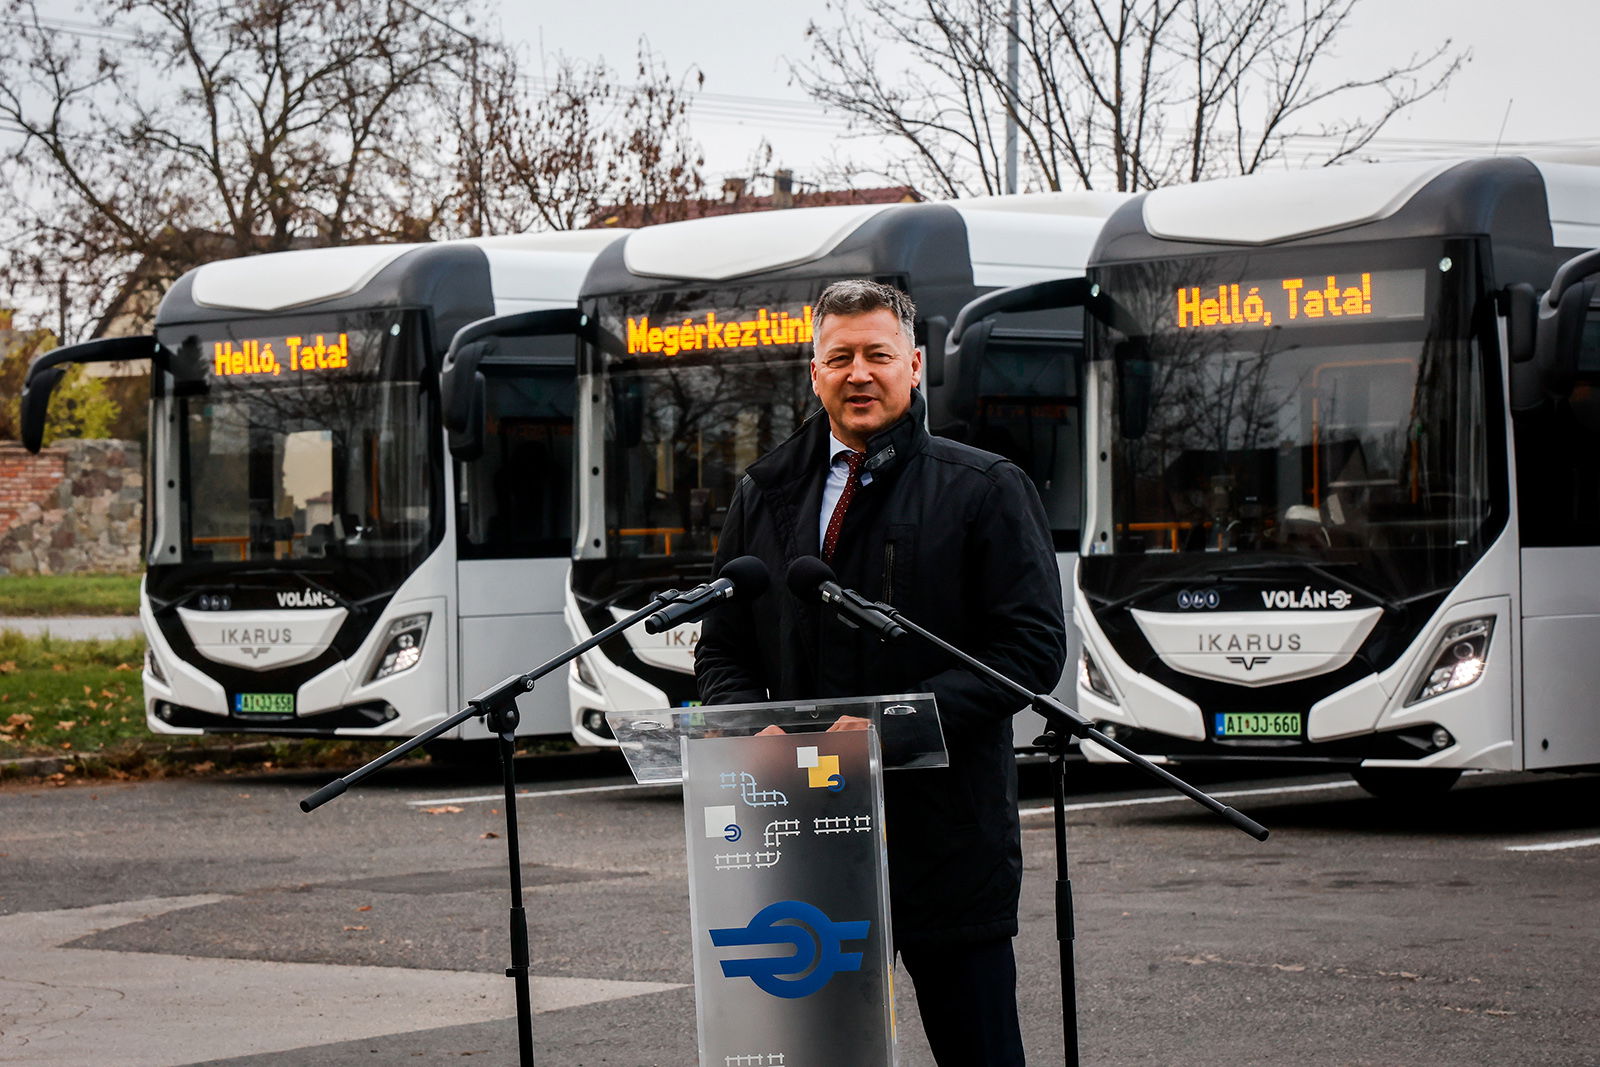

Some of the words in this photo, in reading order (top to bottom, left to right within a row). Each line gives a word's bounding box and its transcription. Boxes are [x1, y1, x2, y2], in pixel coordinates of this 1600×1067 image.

[1177, 283, 1272, 327] Helló,
[1282, 272, 1372, 319] Tata!
[214, 340, 280, 376] Helló,
[285, 333, 348, 371] Tata!
[276, 588, 323, 607] VOLÁN
[1261, 586, 1328, 608] VOLÁN
[222, 628, 292, 643] IKARUS
[665, 631, 699, 646] IKA
[1198, 633, 1302, 651] IKARUS
